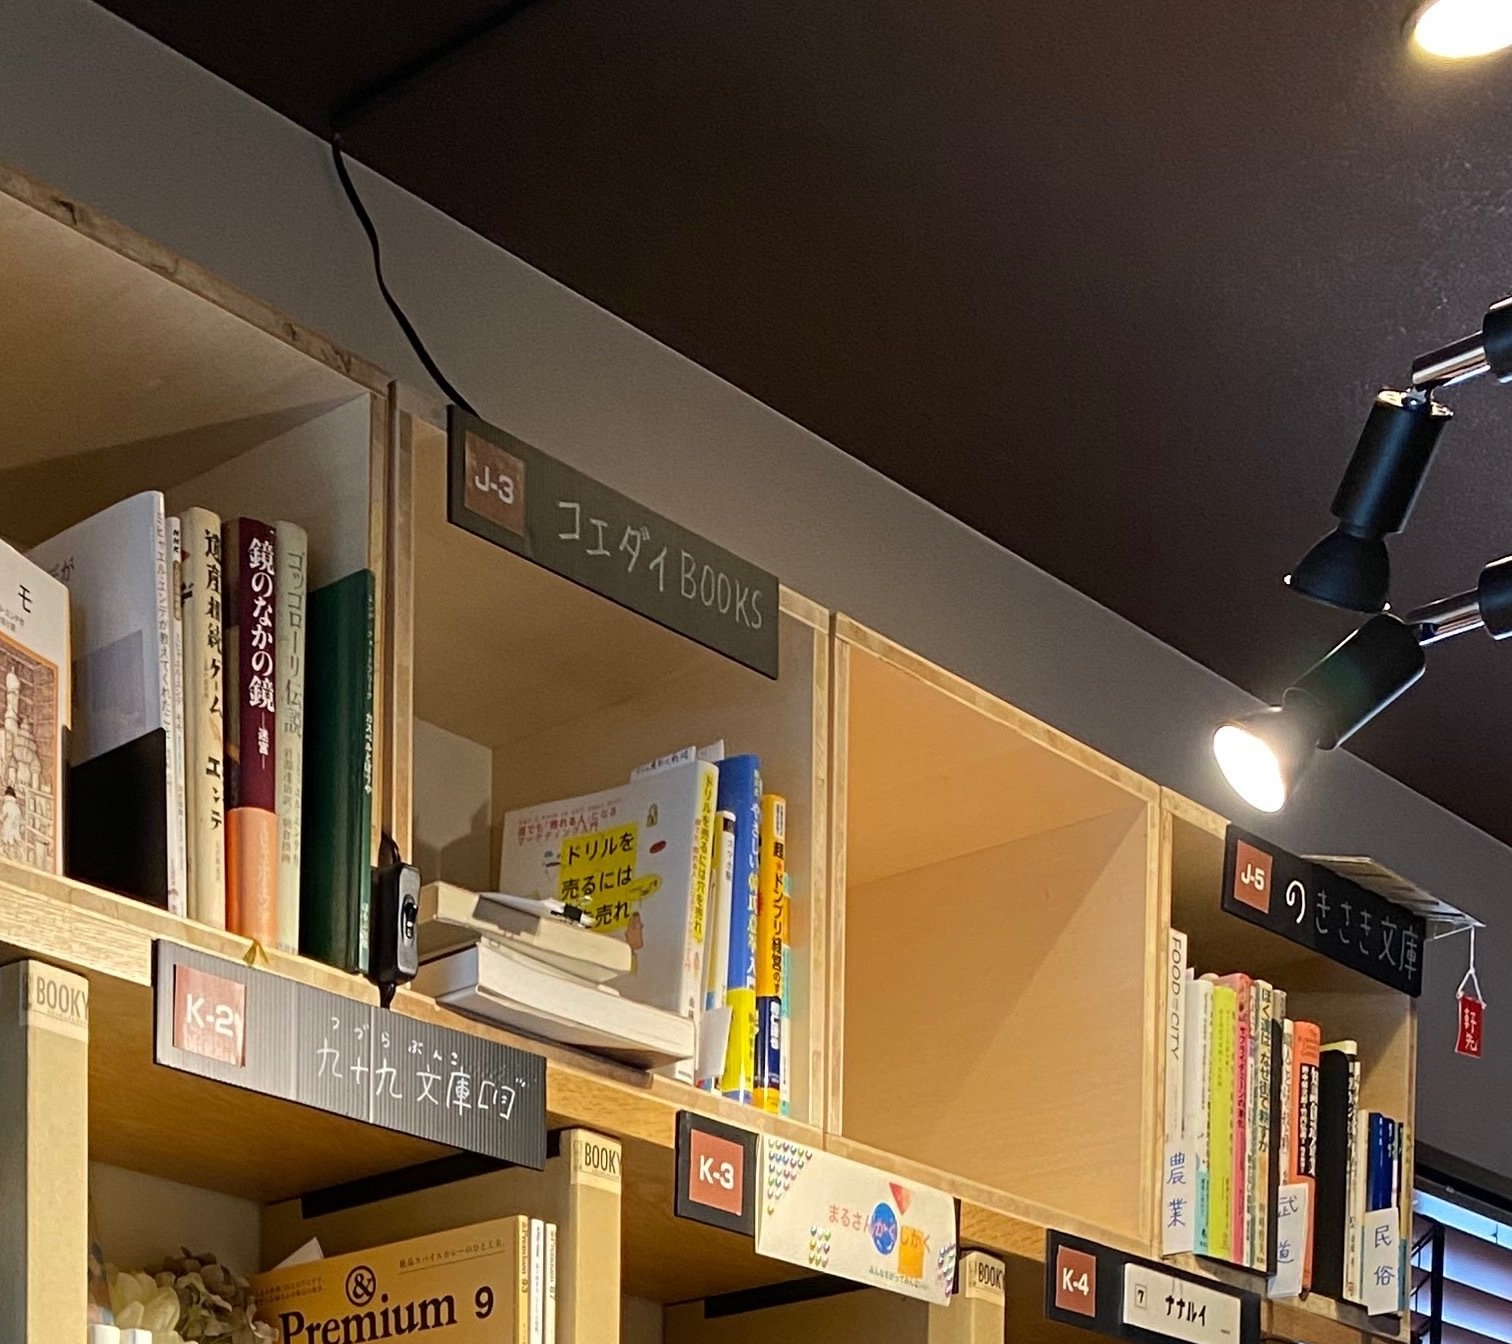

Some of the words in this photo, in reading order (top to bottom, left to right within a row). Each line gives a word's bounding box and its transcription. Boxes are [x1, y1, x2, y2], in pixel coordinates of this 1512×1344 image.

[474, 466, 516, 505] J-3
[247, 538, 276, 713] 鏡のなかの鏡
[568, 831, 634, 865] ドリルを
[561, 865, 632, 900] 売るには
[1240, 869, 1265, 892] J-5
[1286, 880, 1418, 980] のきさき文庫
[186, 993, 236, 1038] K-2
[1462, 1007, 1480, 1051] 軒先
[699, 1158, 735, 1189] K-3
[1167, 1152, 1187, 1229] 農業
[1373, 1224, 1395, 1286] 民俗
[1063, 1267, 1090, 1296] K-4
[474, 1286, 495, 1320] 9
